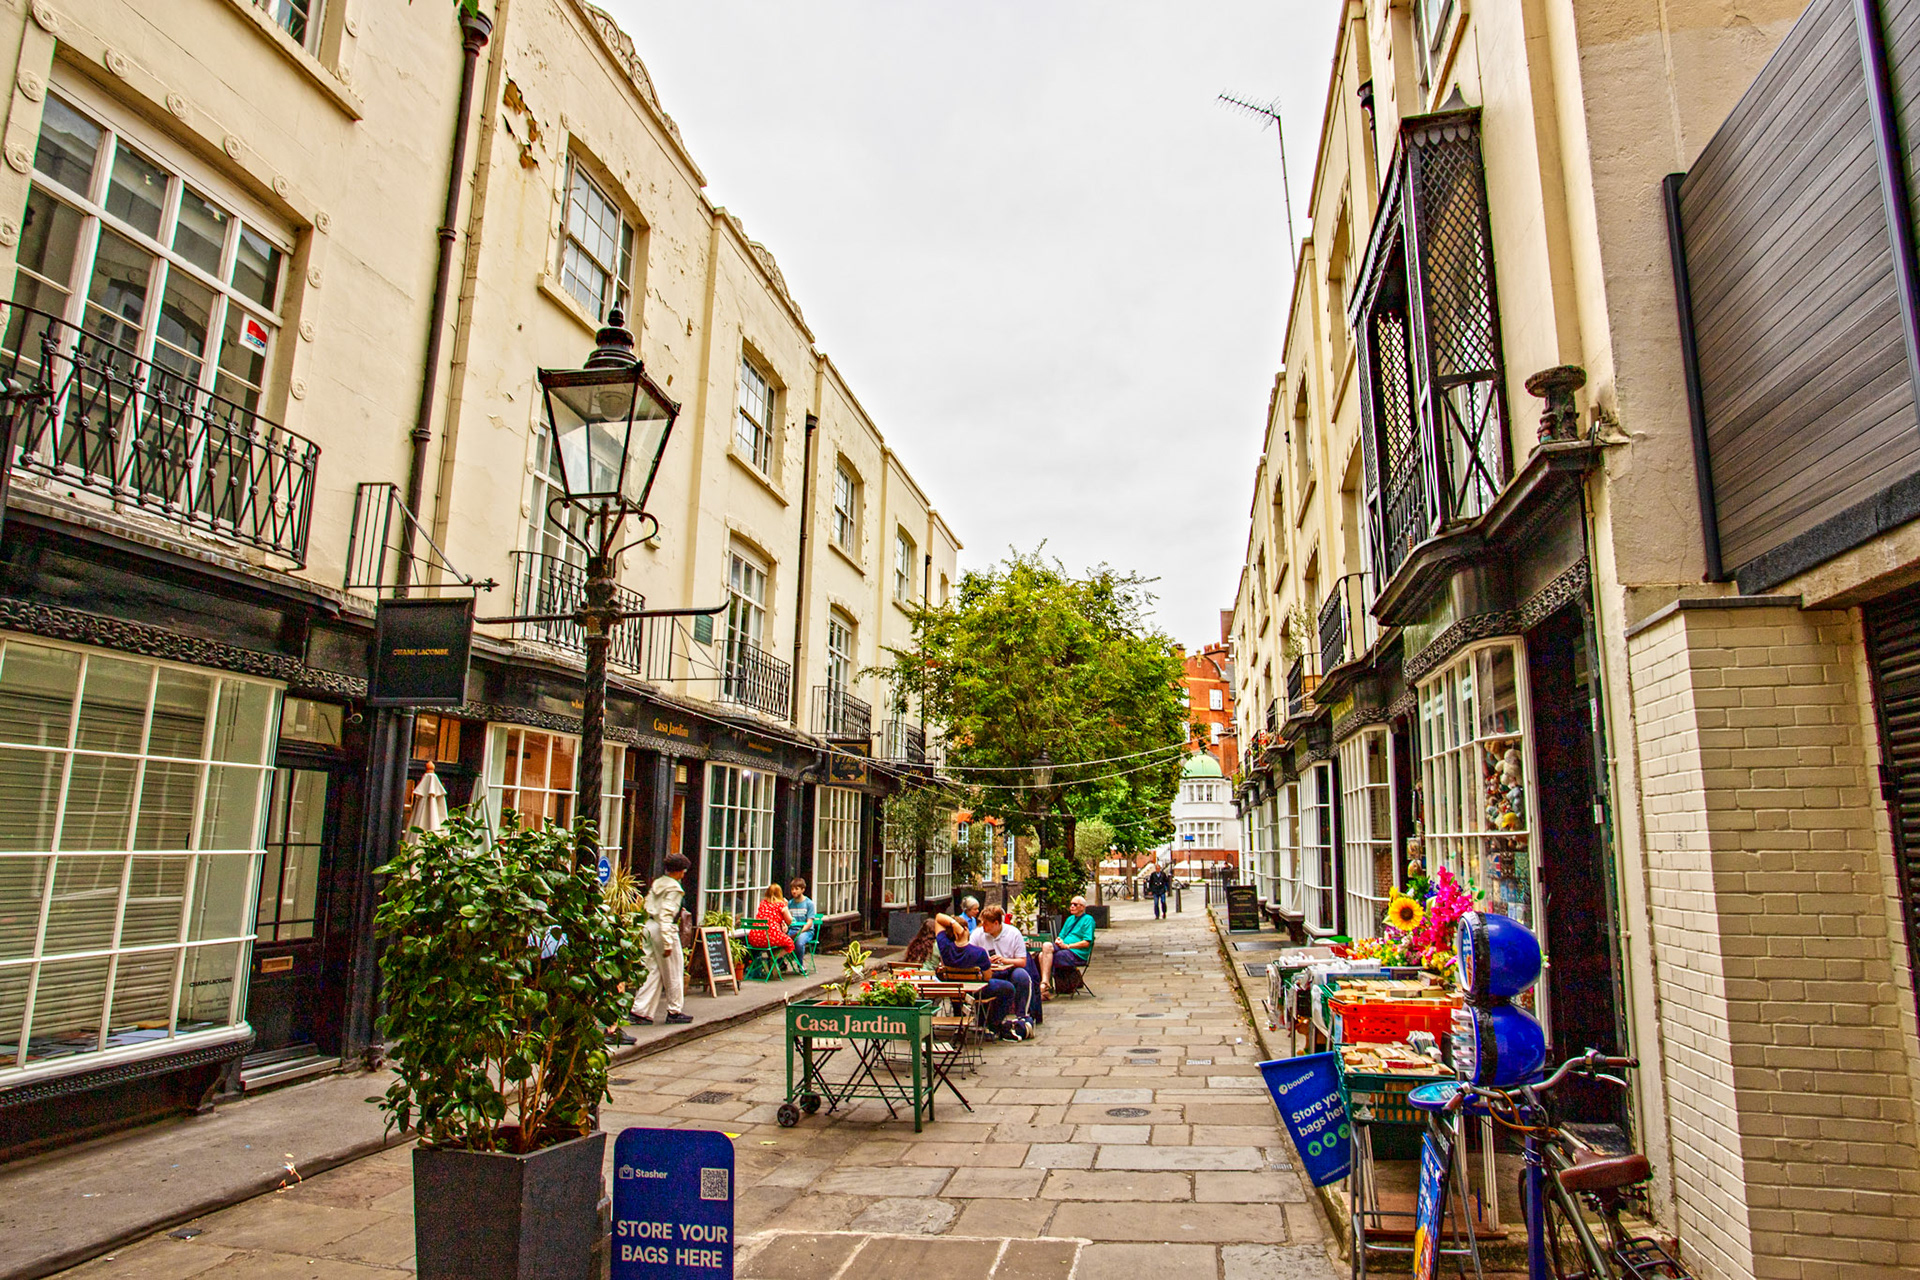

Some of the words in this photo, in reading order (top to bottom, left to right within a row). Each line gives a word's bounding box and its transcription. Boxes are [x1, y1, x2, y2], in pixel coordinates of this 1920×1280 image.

[653, 717, 668, 733] Casa
[667, 721, 689, 738] Jardim
[795, 1013, 839, 1032] Casa
[840, 1014, 908, 1036] Jardim
[1286, 1070, 1315, 1090] bounce
[1291, 1101, 1323, 1124] Store
[1297, 1116, 1327, 1137] bags
[1325, 1104, 1344, 1122] her
[635, 1168, 668, 1179] Stasher
[616, 1219, 673, 1240] STORE
[678, 1223, 728, 1244] YOUR
[621, 1244, 669, 1265] BAGS
[675, 1247, 723, 1269] HERE
